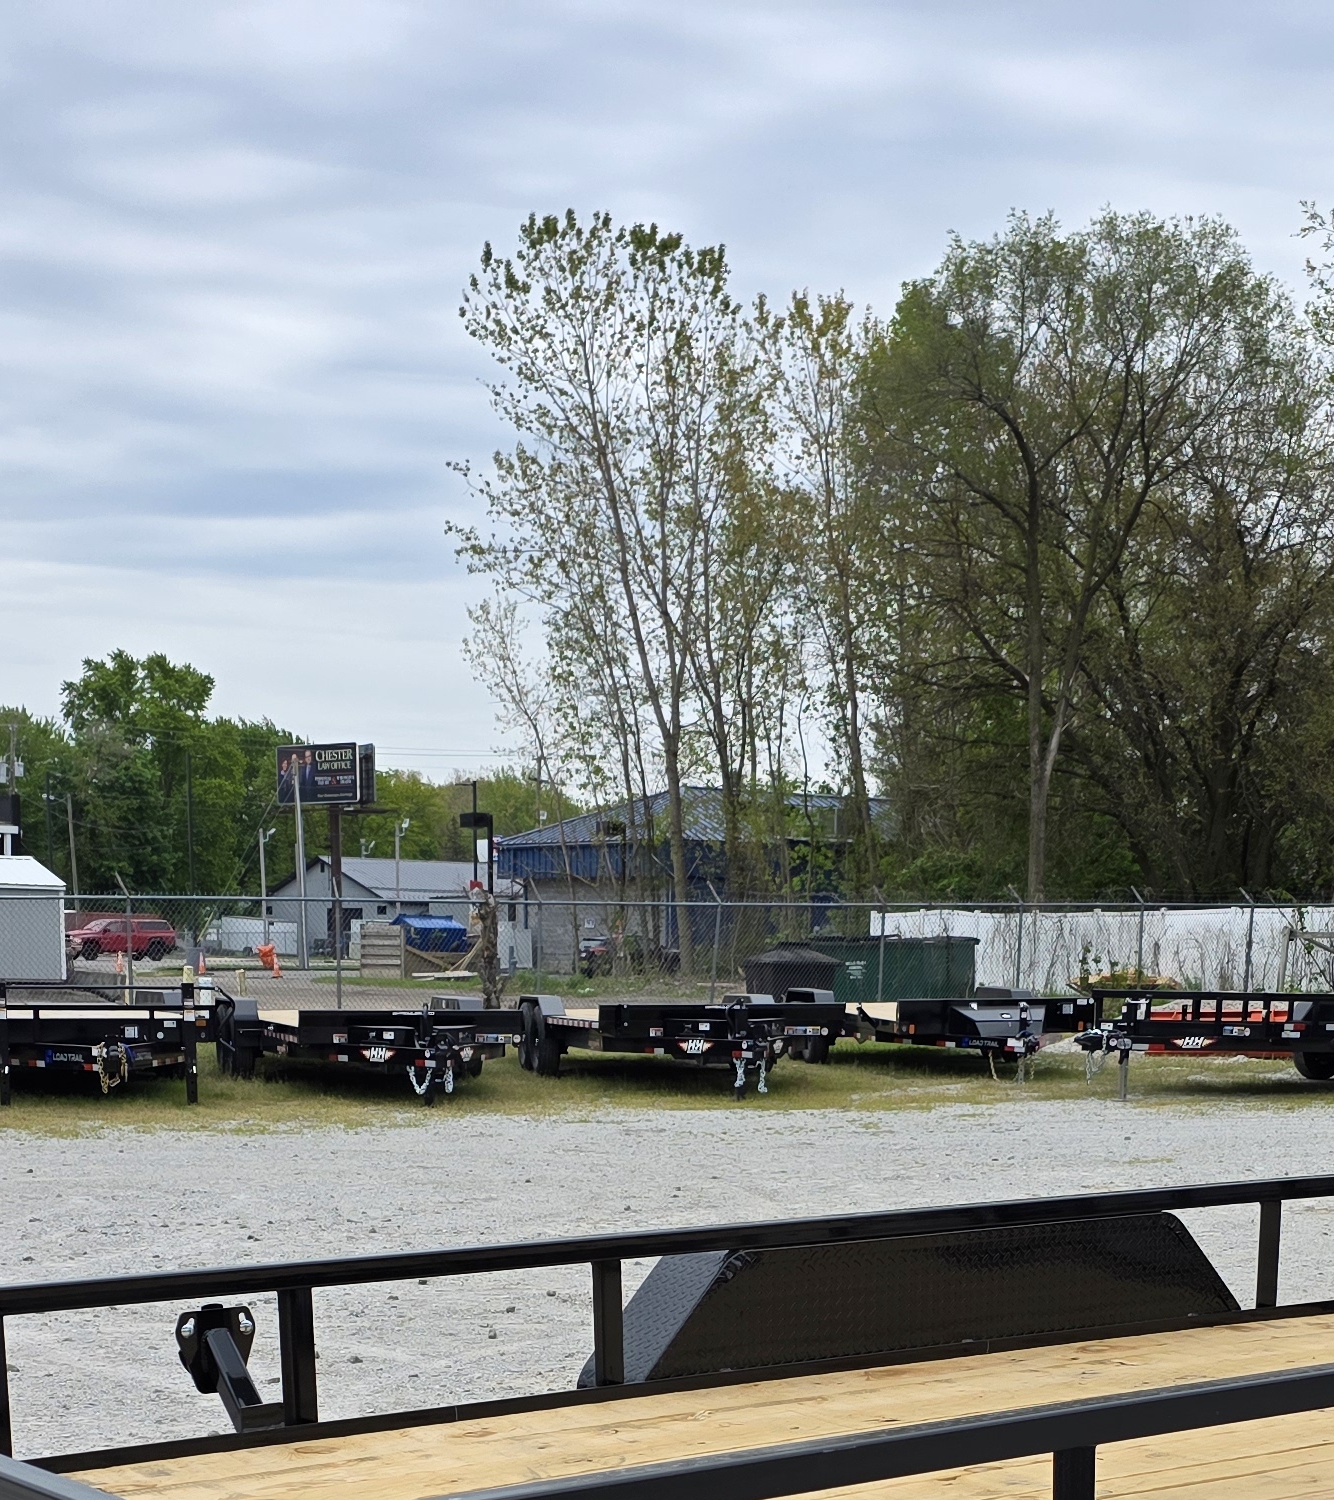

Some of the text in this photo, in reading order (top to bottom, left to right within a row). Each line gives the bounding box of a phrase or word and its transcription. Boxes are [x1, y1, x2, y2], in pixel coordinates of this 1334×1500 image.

[316, 749, 353, 762] CHESTER
[318, 761, 351, 770] LAW OFFICE
[53, 1052, 67, 1061] LOAD
